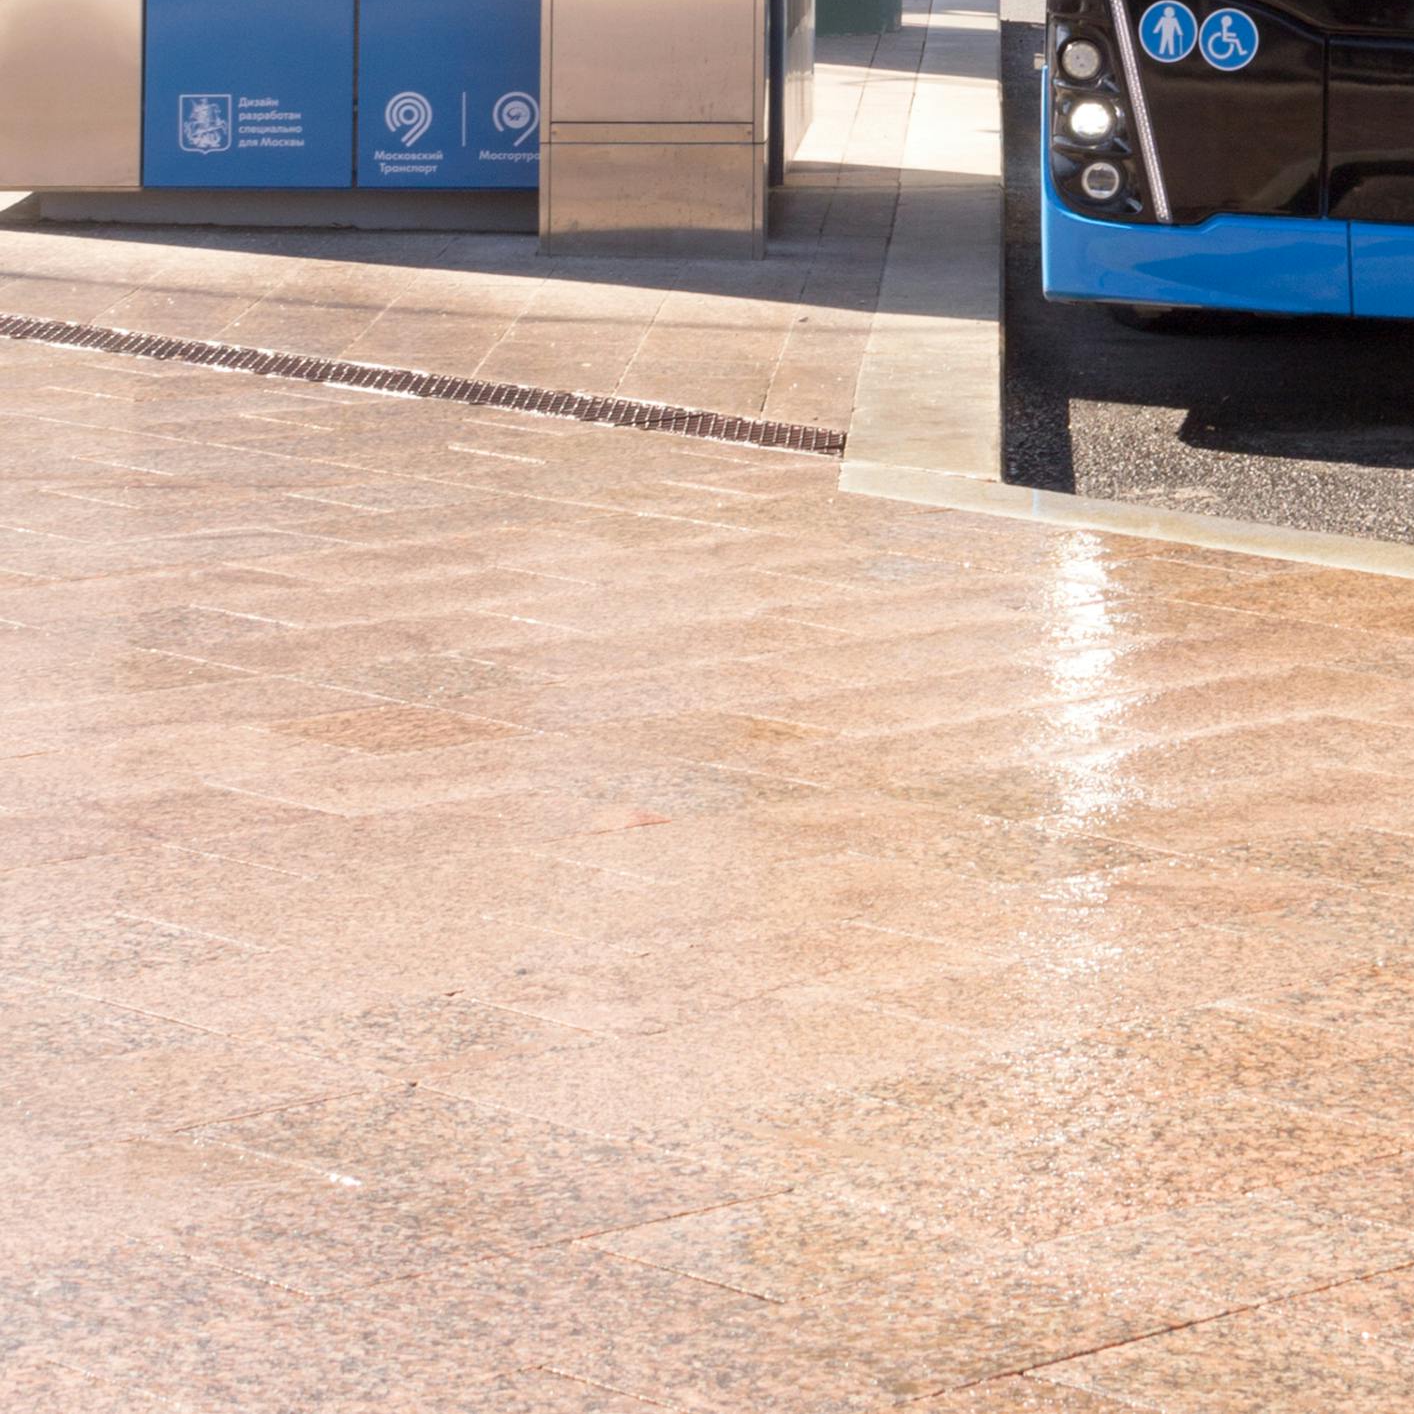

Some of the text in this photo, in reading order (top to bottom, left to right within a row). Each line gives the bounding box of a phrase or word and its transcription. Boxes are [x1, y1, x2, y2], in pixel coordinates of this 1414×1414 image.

[238, 97, 279, 109] Дизайн
[238, 137, 304, 148] для Москвы
[374, 151, 443, 163] Московский
[380, 162, 437, 175] Транспорт
